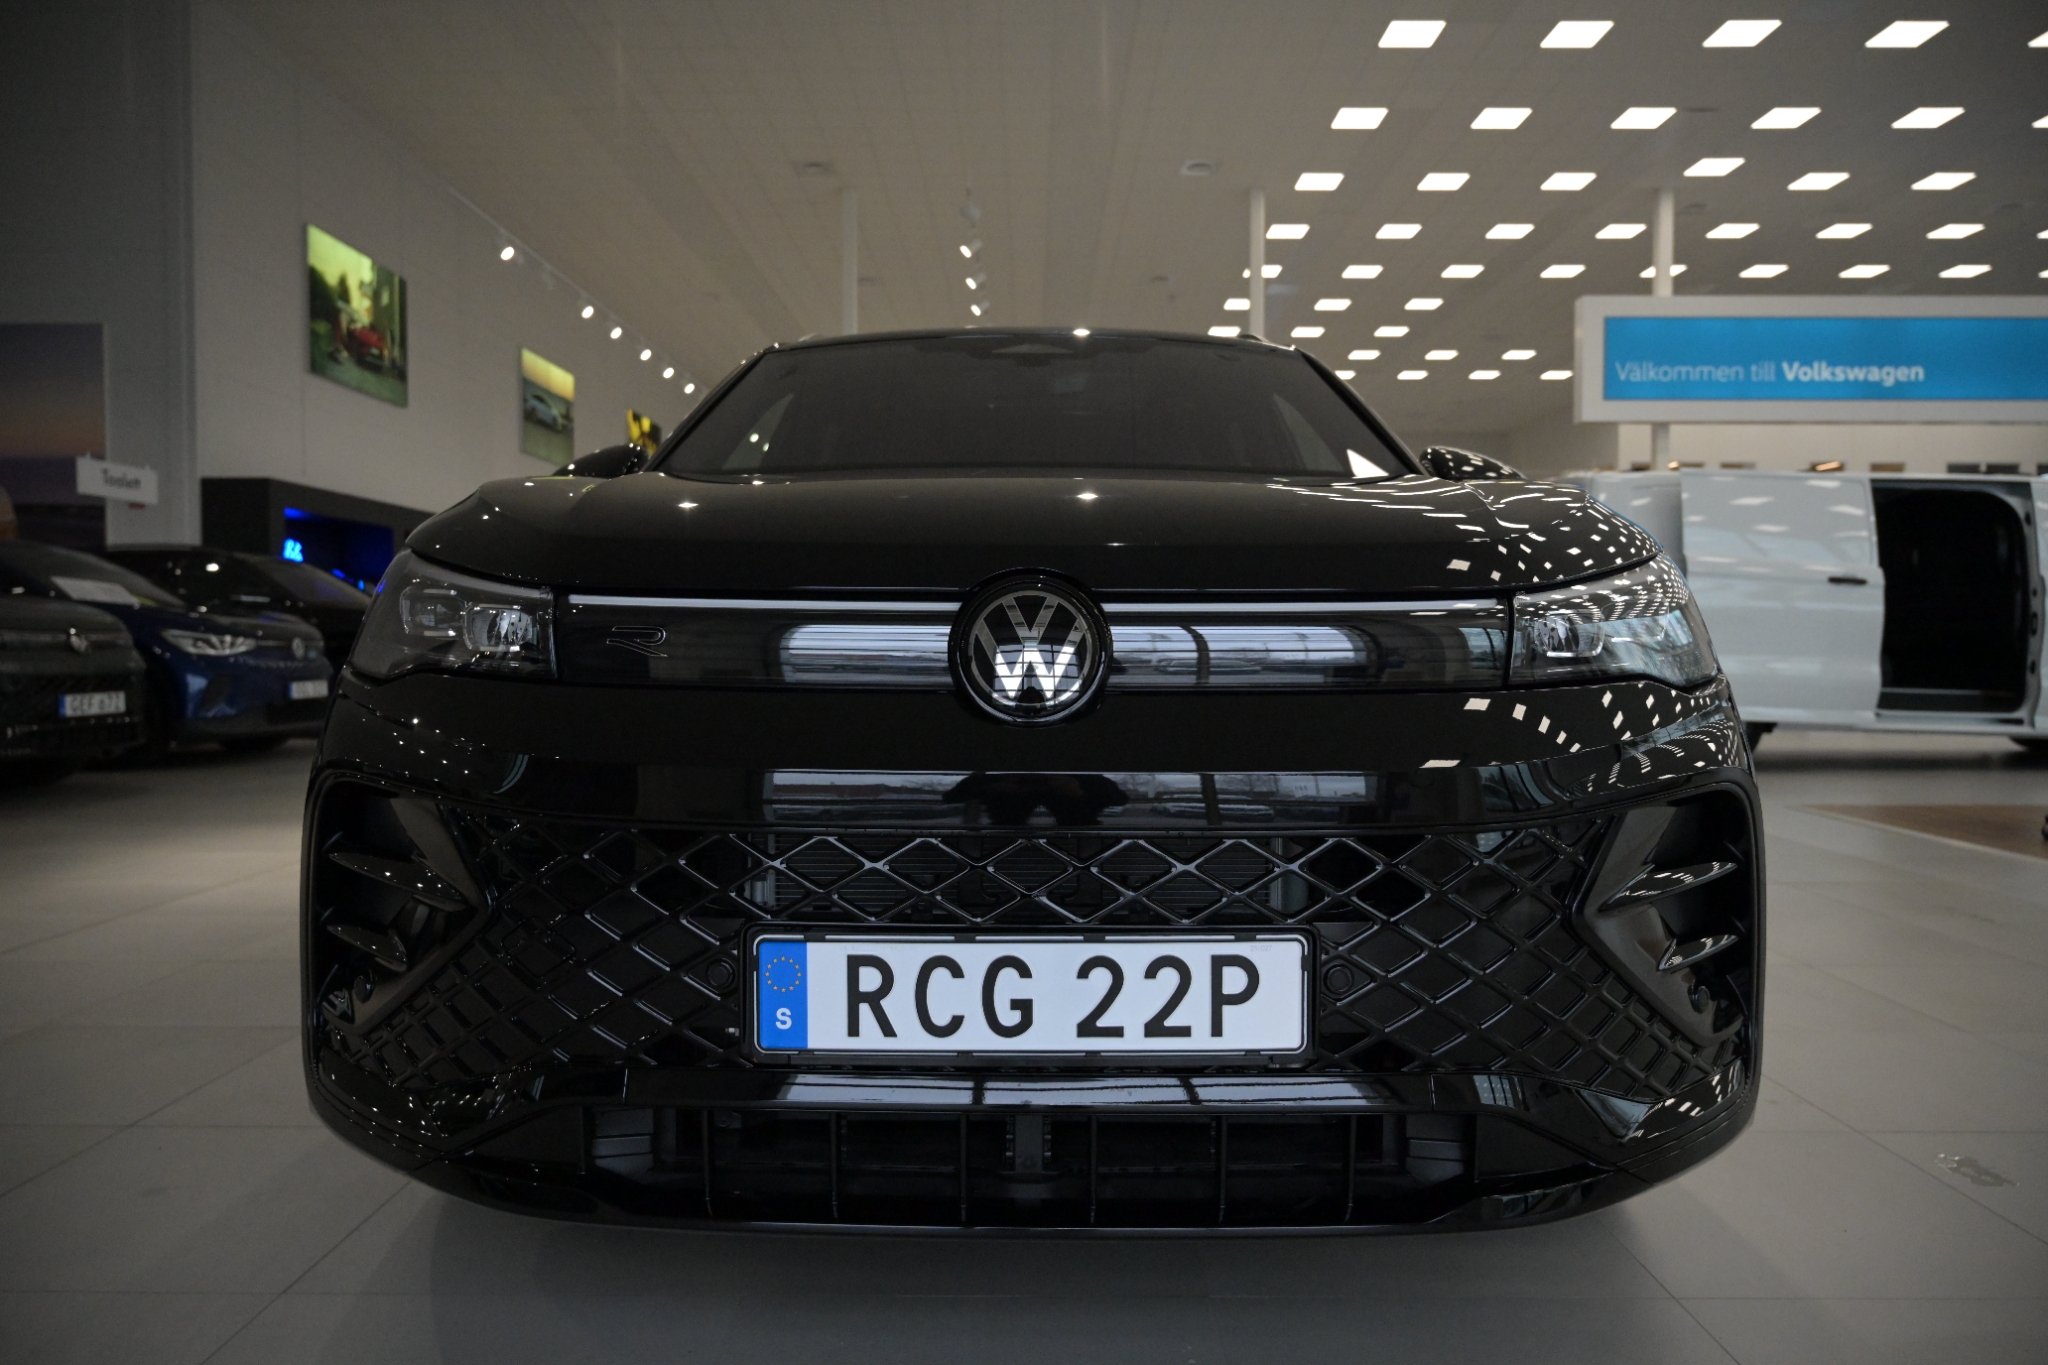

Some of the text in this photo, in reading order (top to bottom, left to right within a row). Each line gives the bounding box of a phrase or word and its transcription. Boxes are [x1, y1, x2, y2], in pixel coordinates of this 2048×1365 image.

[1614, 360, 1925, 387] Välkommen till Volkswagen
[846, 954, 1261, 1038] RCG 22P
[775, 1007, 793, 1030] S
